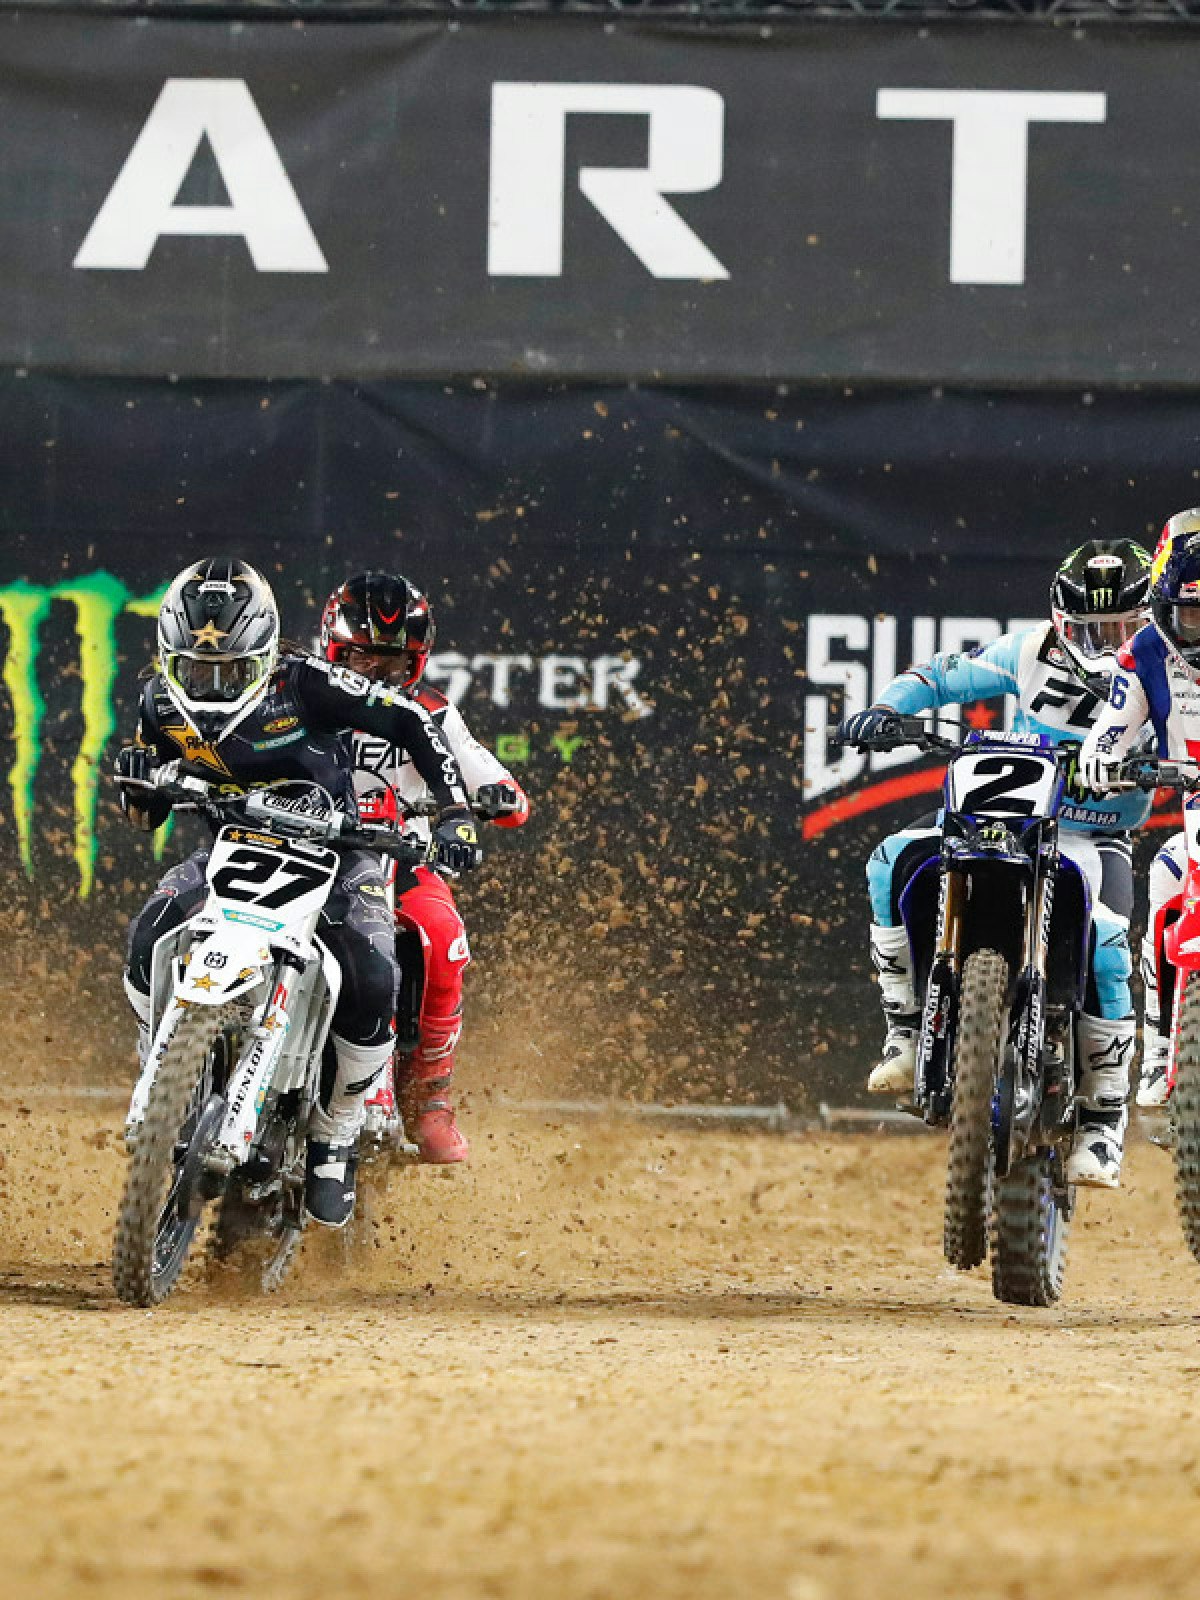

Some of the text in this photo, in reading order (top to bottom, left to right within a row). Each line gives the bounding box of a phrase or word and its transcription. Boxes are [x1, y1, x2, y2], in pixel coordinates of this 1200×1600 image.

[424, 652, 654, 718] STER
[961, 757, 1044, 817] 2
[1058, 805, 1118, 824] YAMAHA
[211, 848, 334, 910] 27
[1027, 993, 1041, 1077] DUNLOP
[231, 1041, 264, 1117] DUNLOP
